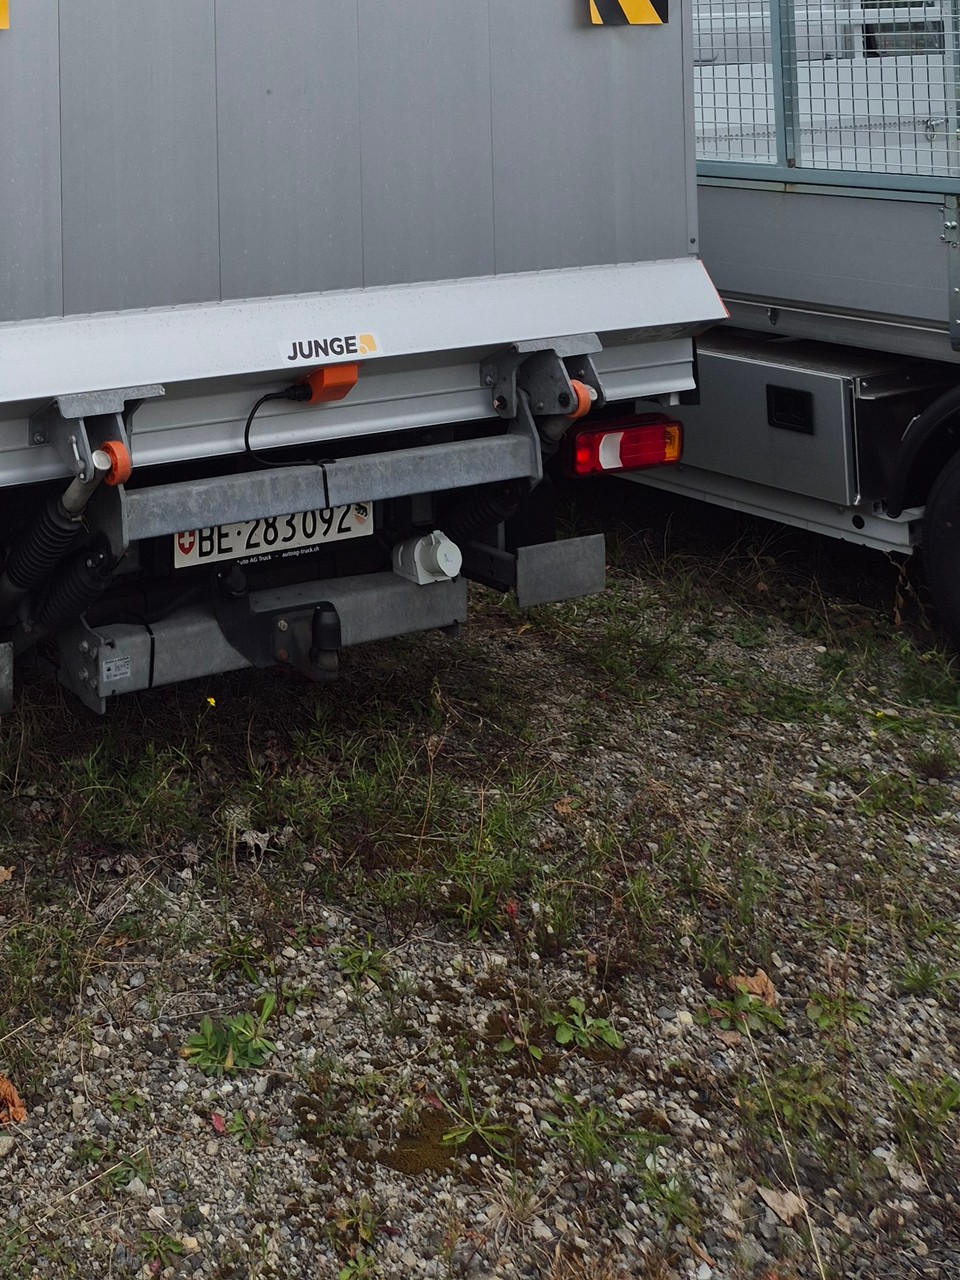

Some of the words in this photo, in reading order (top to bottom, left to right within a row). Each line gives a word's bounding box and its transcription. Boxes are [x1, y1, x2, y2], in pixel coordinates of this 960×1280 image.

[287, 335, 358, 361] JUNGE
[258, 554, 272, 562] Truck
[282, 545, 320, 558] autoag-truck.ch
